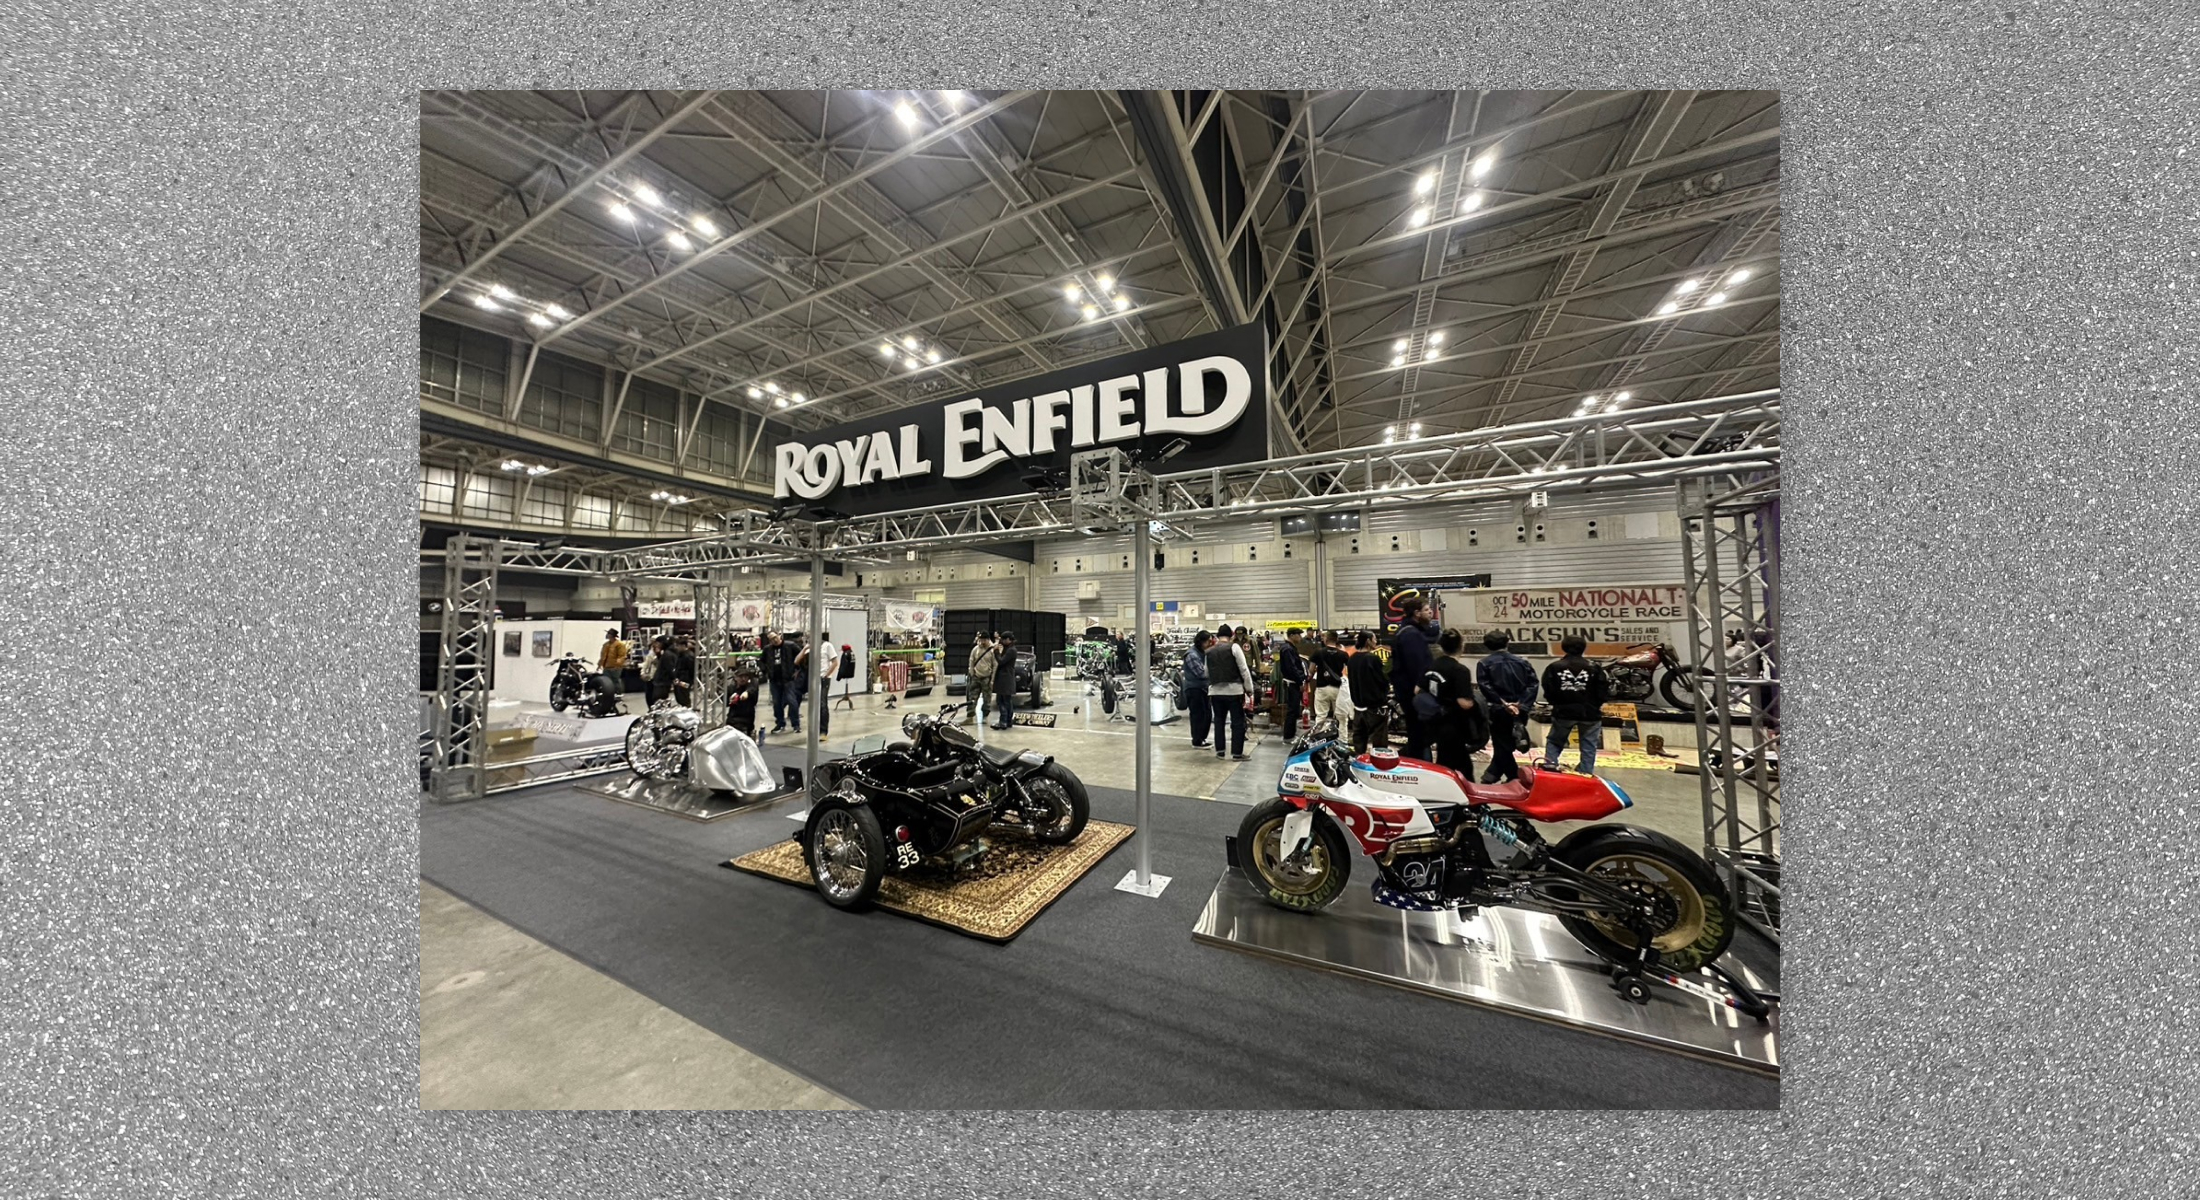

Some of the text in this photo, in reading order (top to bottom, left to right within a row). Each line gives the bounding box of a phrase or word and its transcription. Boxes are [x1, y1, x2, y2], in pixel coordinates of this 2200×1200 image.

[774, 355, 1251, 499] ROYAL ENFIELD
[1493, 596, 1508, 605] OCT
[1511, 592, 1528, 608] 50
[1529, 597, 1555, 607] MILE
[1559, 589, 1663, 607] NATIONAL
[1494, 606, 1508, 618] 24
[1519, 606, 1682, 619] MOTORCYCLE RACE
[1285, 773, 1299, 781] EBC
[1392, 774, 1419, 782] ENFIELD
[896, 841, 914, 856] RE
[897, 851, 920, 869] 33
